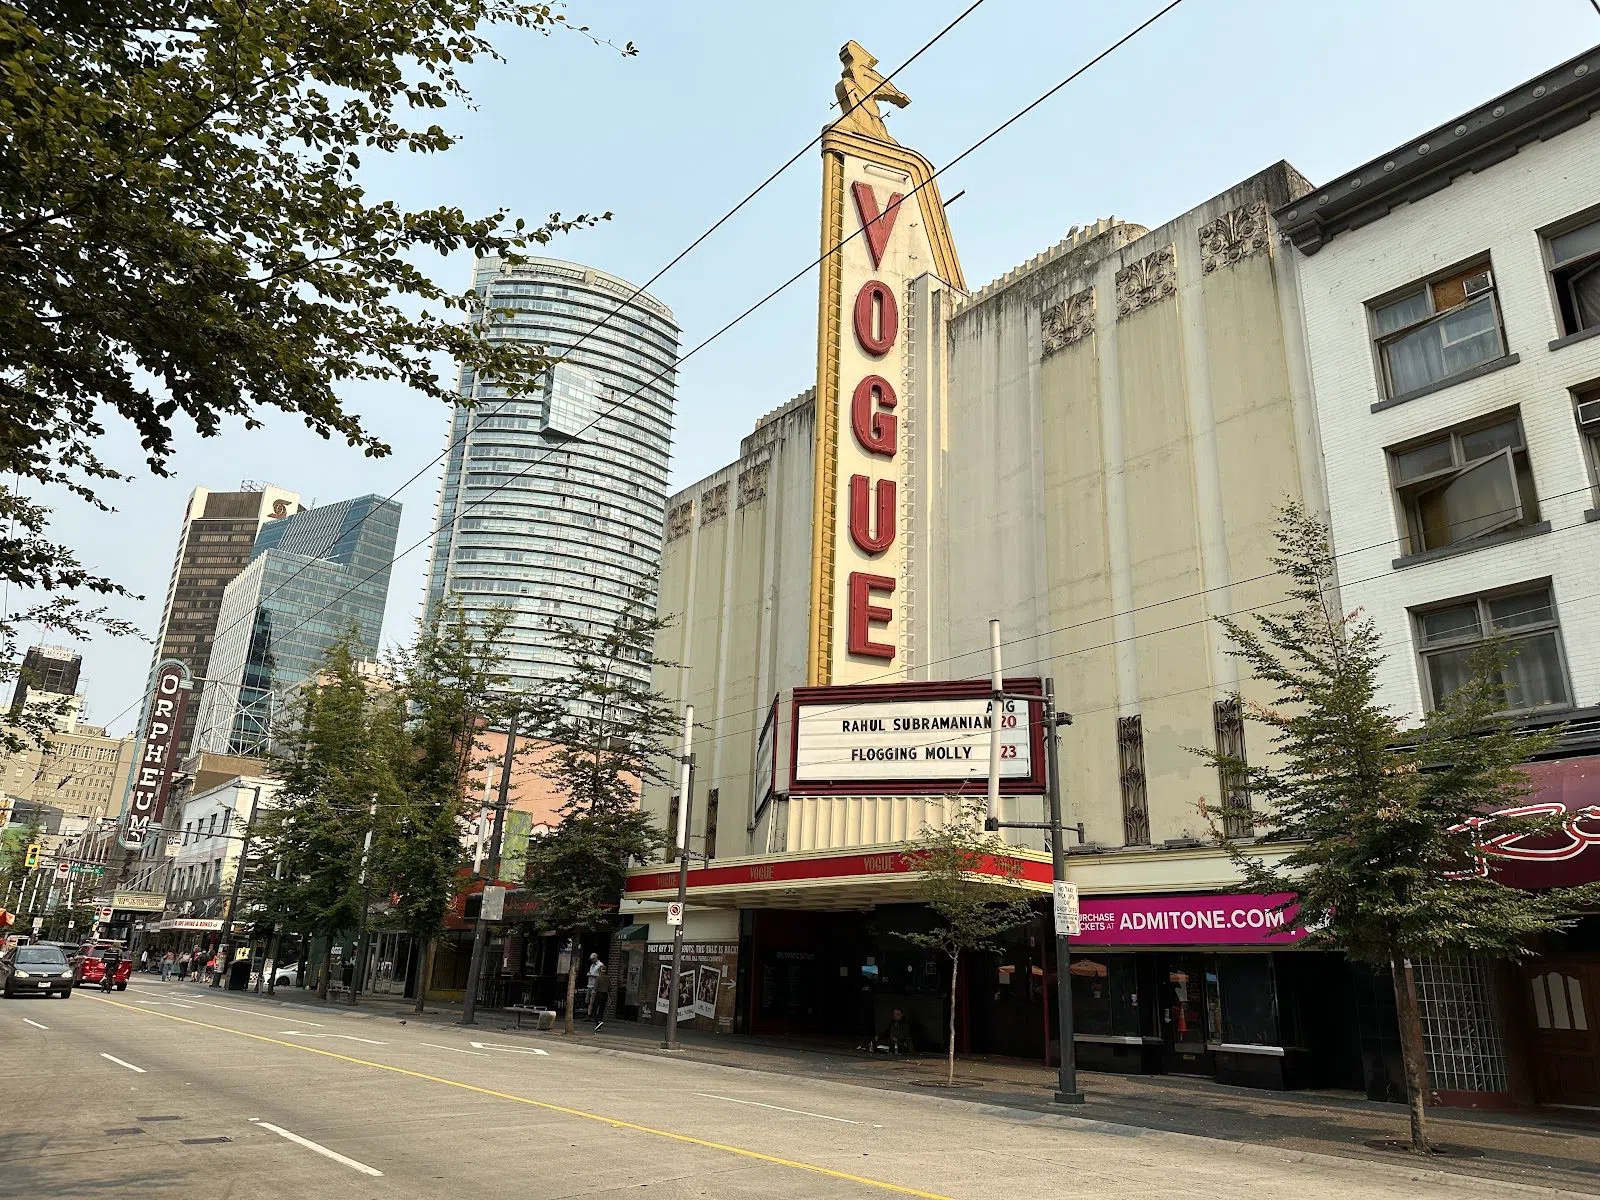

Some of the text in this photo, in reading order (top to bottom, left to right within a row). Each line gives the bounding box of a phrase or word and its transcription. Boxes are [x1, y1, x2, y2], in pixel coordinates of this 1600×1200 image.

[848, 180, 905, 659] VOGUE
[842, 714, 1017, 732] RAHUL SUBRAMANIAN 20
[130, 674, 180, 831] ORPHEUM
[851, 745, 1017, 761] FLOGGING MOLLY 23
[863, 854, 895, 872] VOGUE
[749, 865, 774, 880] VOGUE
[1079, 912, 1115, 922] URCHASE
[1079, 922, 1106, 930] CKETS
[1119, 908, 1285, 931] ADMITONE.COM
